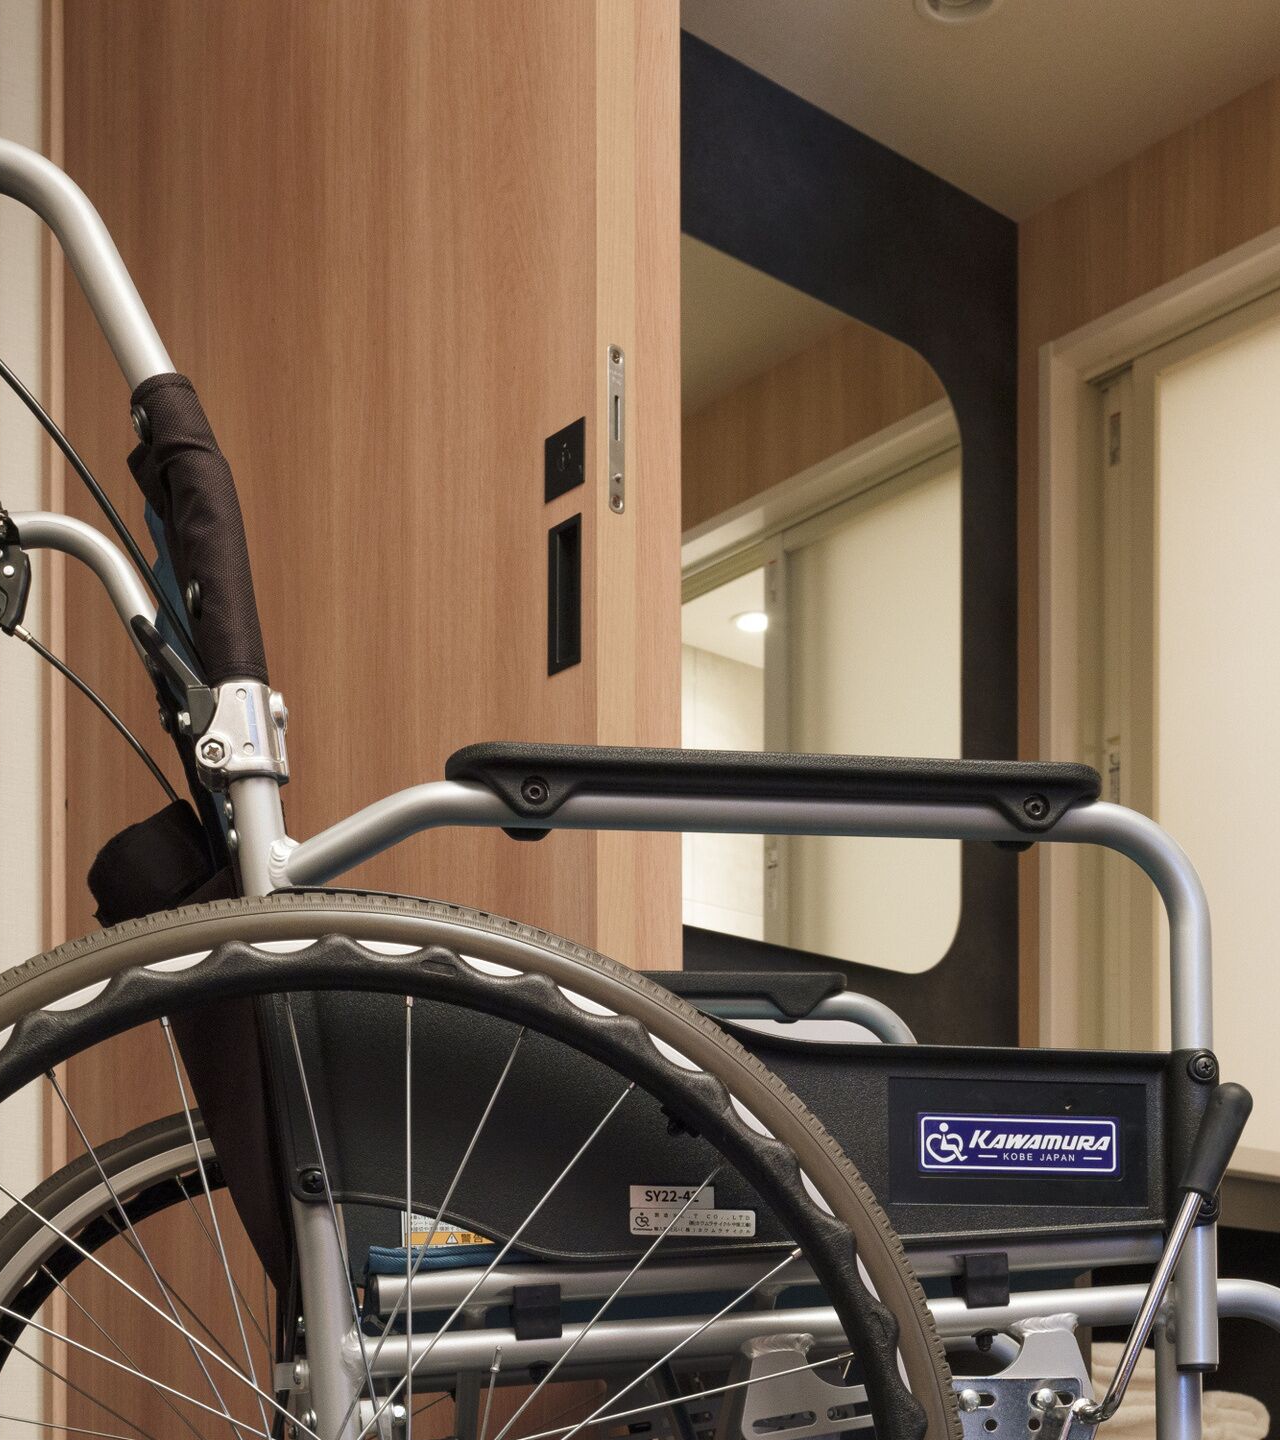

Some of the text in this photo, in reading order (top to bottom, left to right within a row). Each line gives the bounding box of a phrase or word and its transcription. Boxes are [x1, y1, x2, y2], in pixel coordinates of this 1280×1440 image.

[969, 1129, 1112, 1151] KAWAMURA
[1003, 1152, 1076, 1162] KOBE JAPAN
